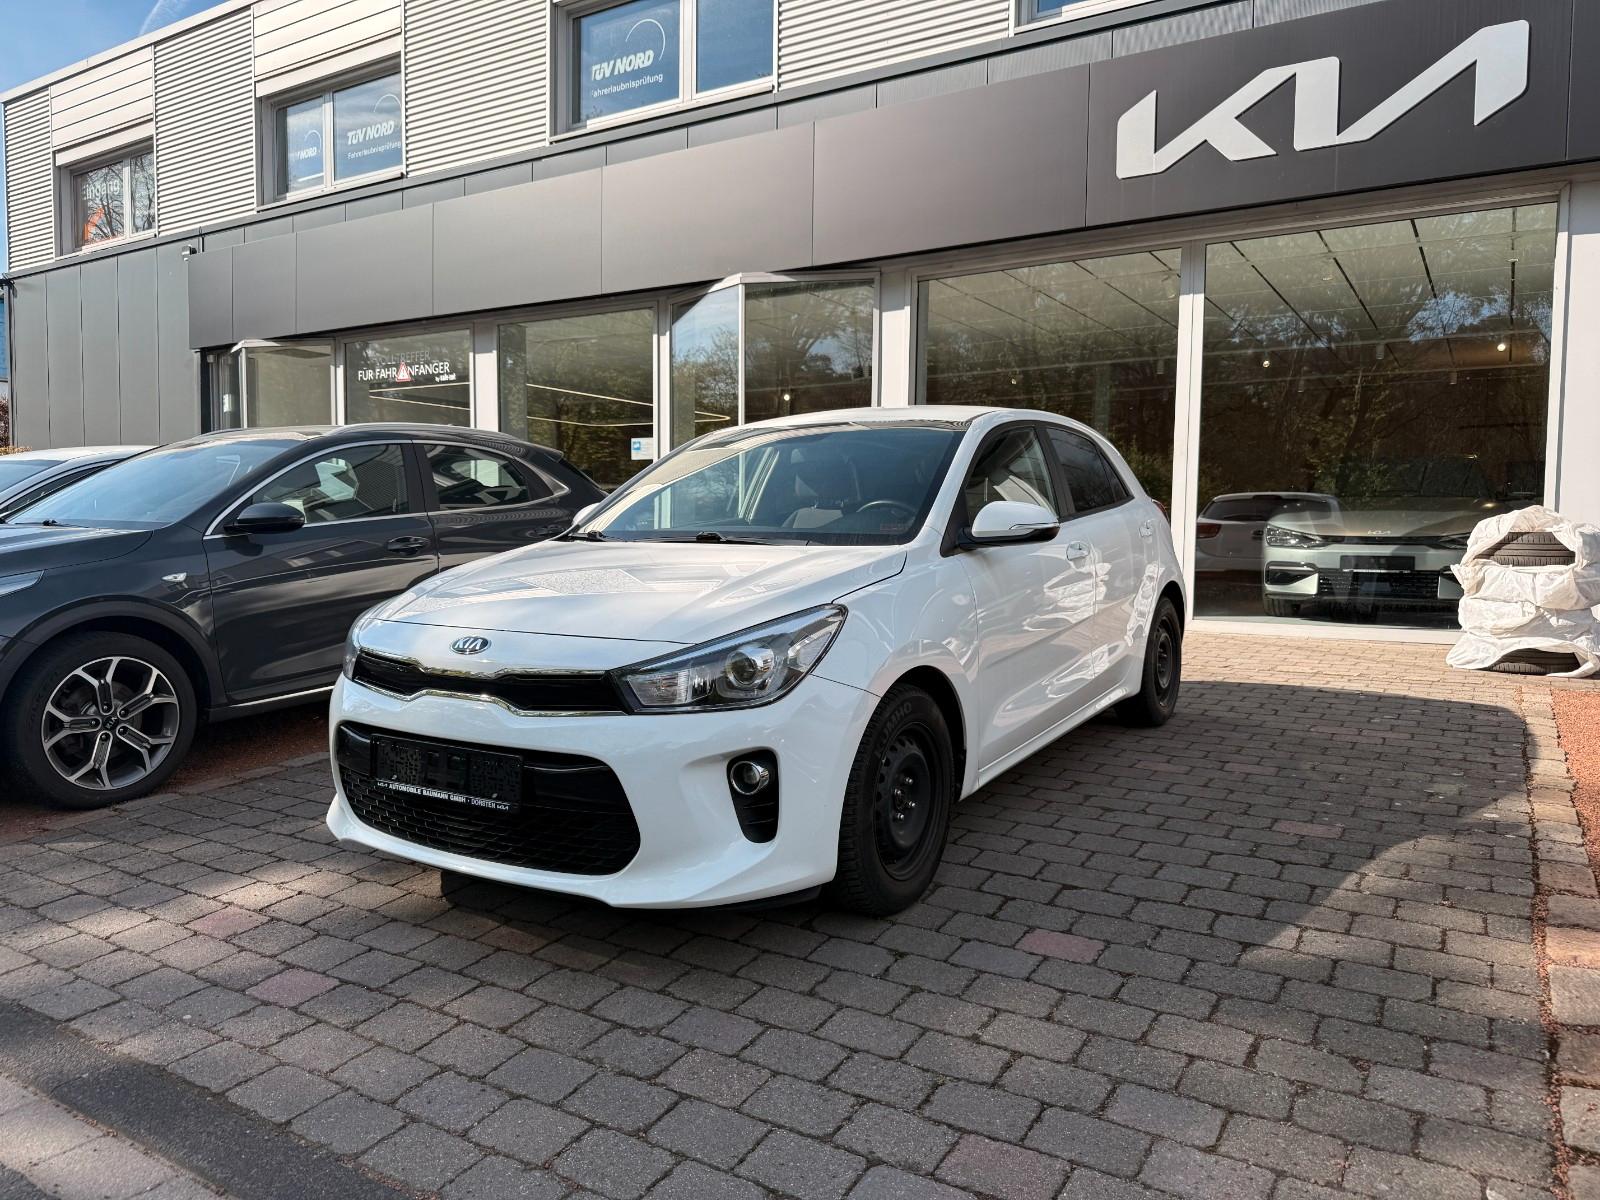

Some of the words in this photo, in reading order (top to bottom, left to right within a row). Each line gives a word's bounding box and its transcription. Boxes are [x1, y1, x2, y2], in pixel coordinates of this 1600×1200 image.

[614, 49, 654, 75] NORD
[347, 128, 366, 145] TÜV
[366, 121, 394, 140] NORD
[300, 146, 317, 160] NORD
[358, 367, 373, 381] FÜR
[453, 637, 485, 650] KIA
[389, 784, 421, 794] AUTOMOBILE
[423, 789, 448, 799] BAUMANN
[471, 798, 495, 808] DORSTEN
